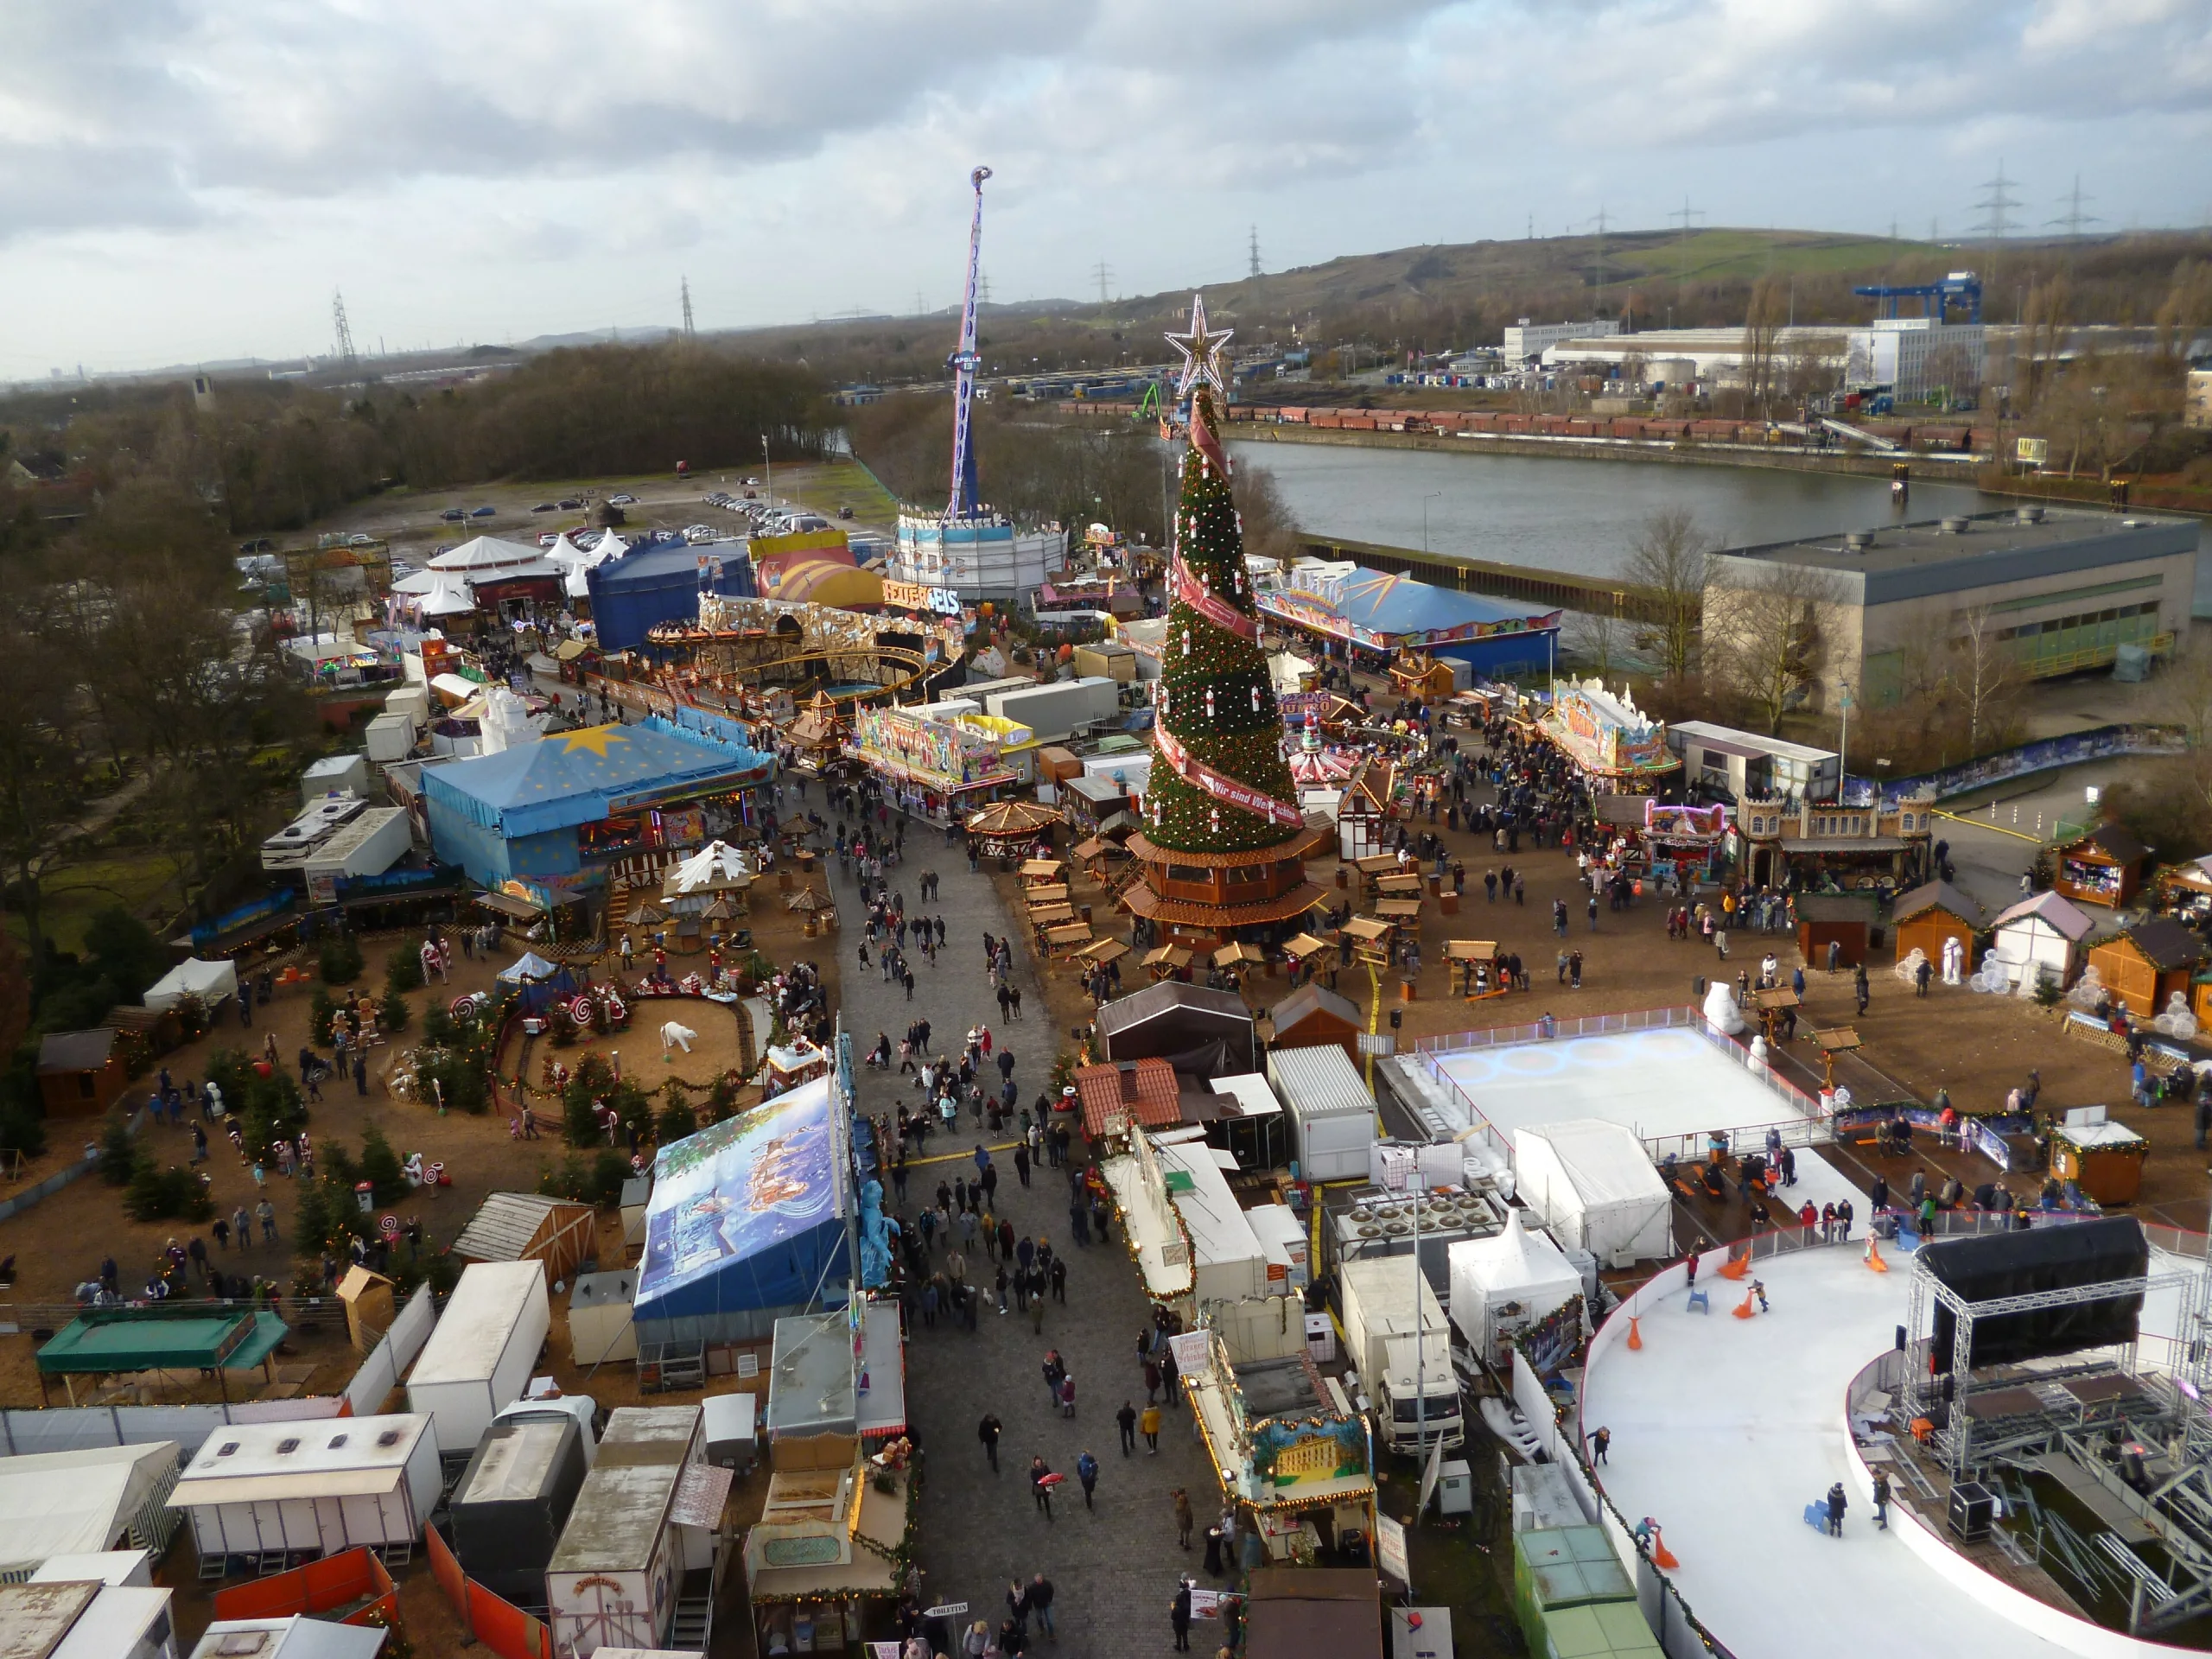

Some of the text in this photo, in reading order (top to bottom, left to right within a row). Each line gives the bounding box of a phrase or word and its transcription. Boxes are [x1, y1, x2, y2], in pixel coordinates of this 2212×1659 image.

[1213, 781, 1229, 796] Wir
[1230, 789, 1252, 804] sind
[1252, 795, 1296, 821] Weiachten
[932, 1605, 967, 1616] TOILETTEN
